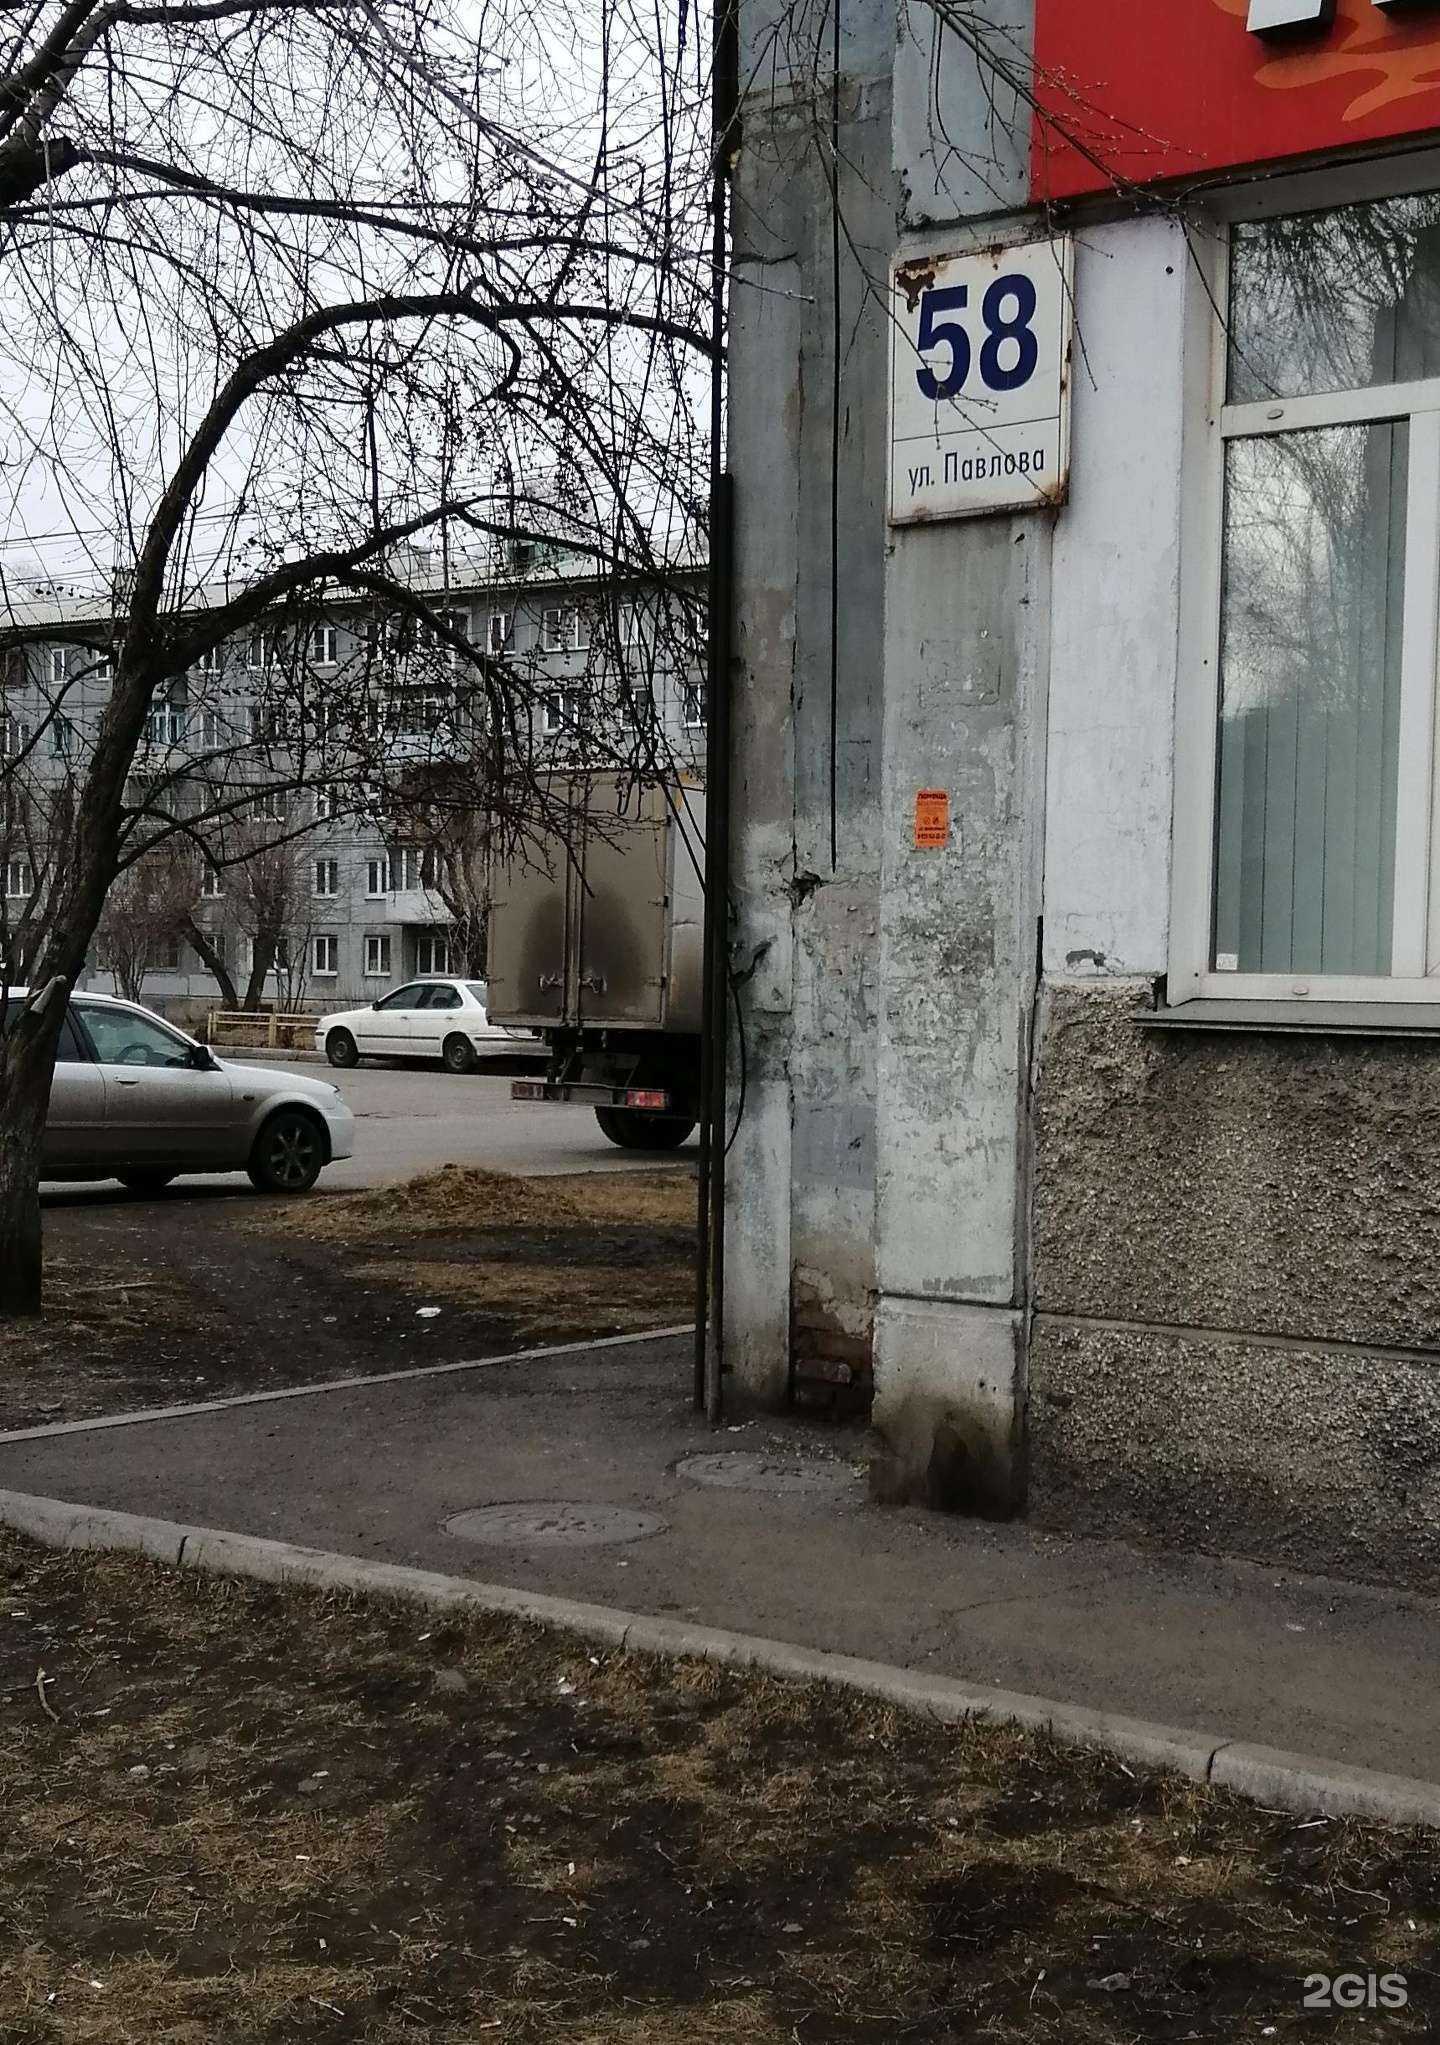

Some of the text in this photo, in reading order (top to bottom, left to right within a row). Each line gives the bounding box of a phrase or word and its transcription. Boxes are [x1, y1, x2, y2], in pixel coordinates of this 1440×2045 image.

[915, 273, 1038, 401] 58
[908, 448, 1045, 496] ул. Павлова
